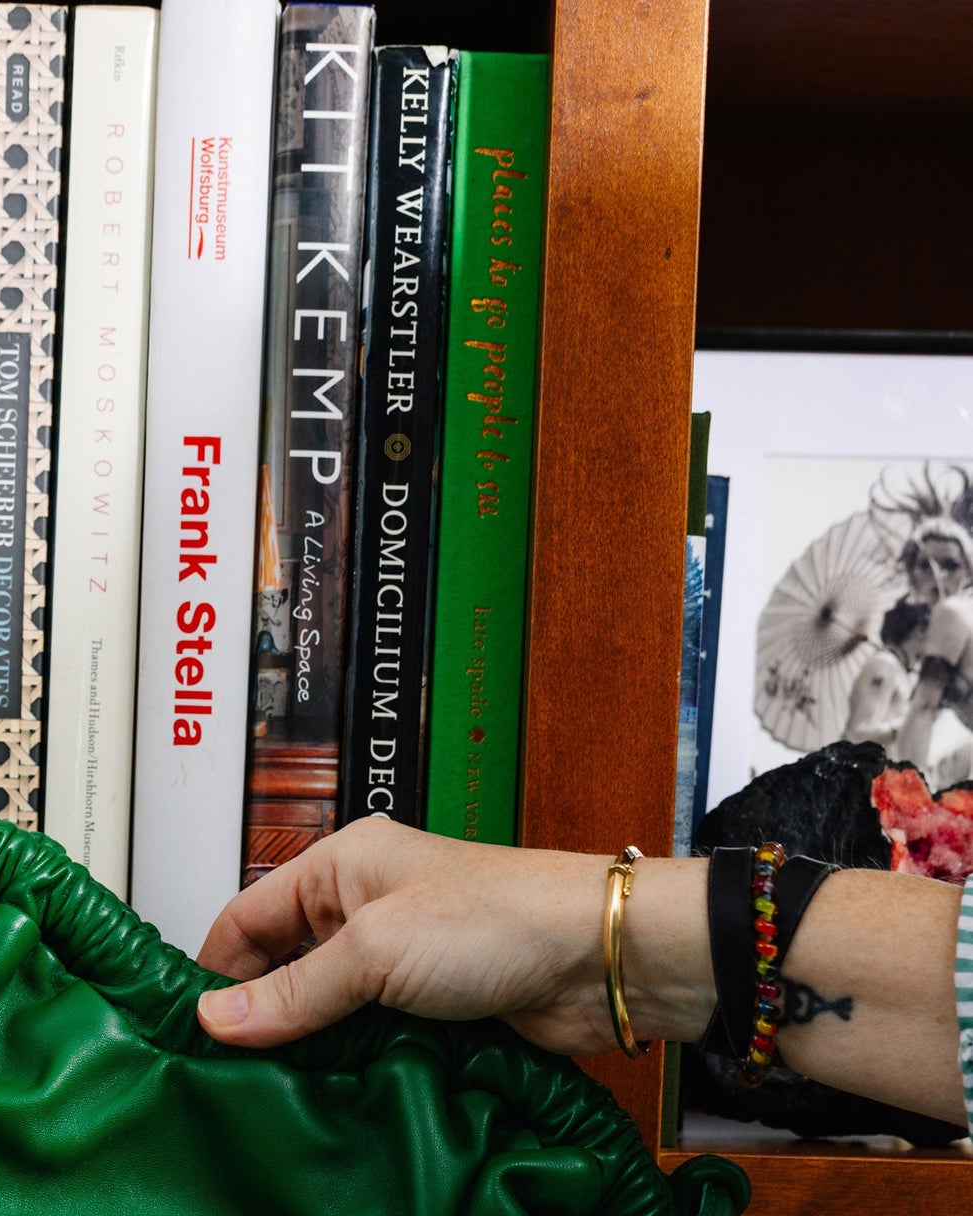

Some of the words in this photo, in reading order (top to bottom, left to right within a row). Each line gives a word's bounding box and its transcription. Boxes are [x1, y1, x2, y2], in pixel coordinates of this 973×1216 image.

[11, 64, 24, 114] READ
[114, 45, 125, 82] Rifkin
[301, 43, 359, 191] KIT
[398, 67, 430, 174] KELLY
[100, 123, 125, 294] ROBERT
[197, 137, 215, 224] Wolfsburg
[215, 137, 233, 261] Kunstmuseum
[474, 147, 527, 247] places
[386, 186, 425, 415] WEARSTLER
[490, 257, 521, 287] to
[470, 298, 507, 330] go
[289, 242, 350, 485] KEMP
[464, 340, 518, 439] people
[88, 326, 116, 593] MOSKOWITZ
[476, 449, 509, 473] to
[477, 480, 501, 519] see
[178, 436, 221, 582] Frank
[304, 510, 325, 528] A
[292, 536, 324, 621] Living
[371, 482, 409, 720] DOMICILIUM
[90, 638, 103, 683] Thames
[294, 628, 320, 703] Space
[473, 606, 493, 651] kate
[89, 684, 101, 706] and
[172, 602, 216, 746] Stella
[465, 657, 489, 718] spade
[84, 708, 100, 818] Hudson/Hirshhorn
[367, 737, 396, 819] DEC
[466, 753, 480, 793] NEW
[83, 821, 96, 868] Museum
[463, 800, 479, 842] YOR
